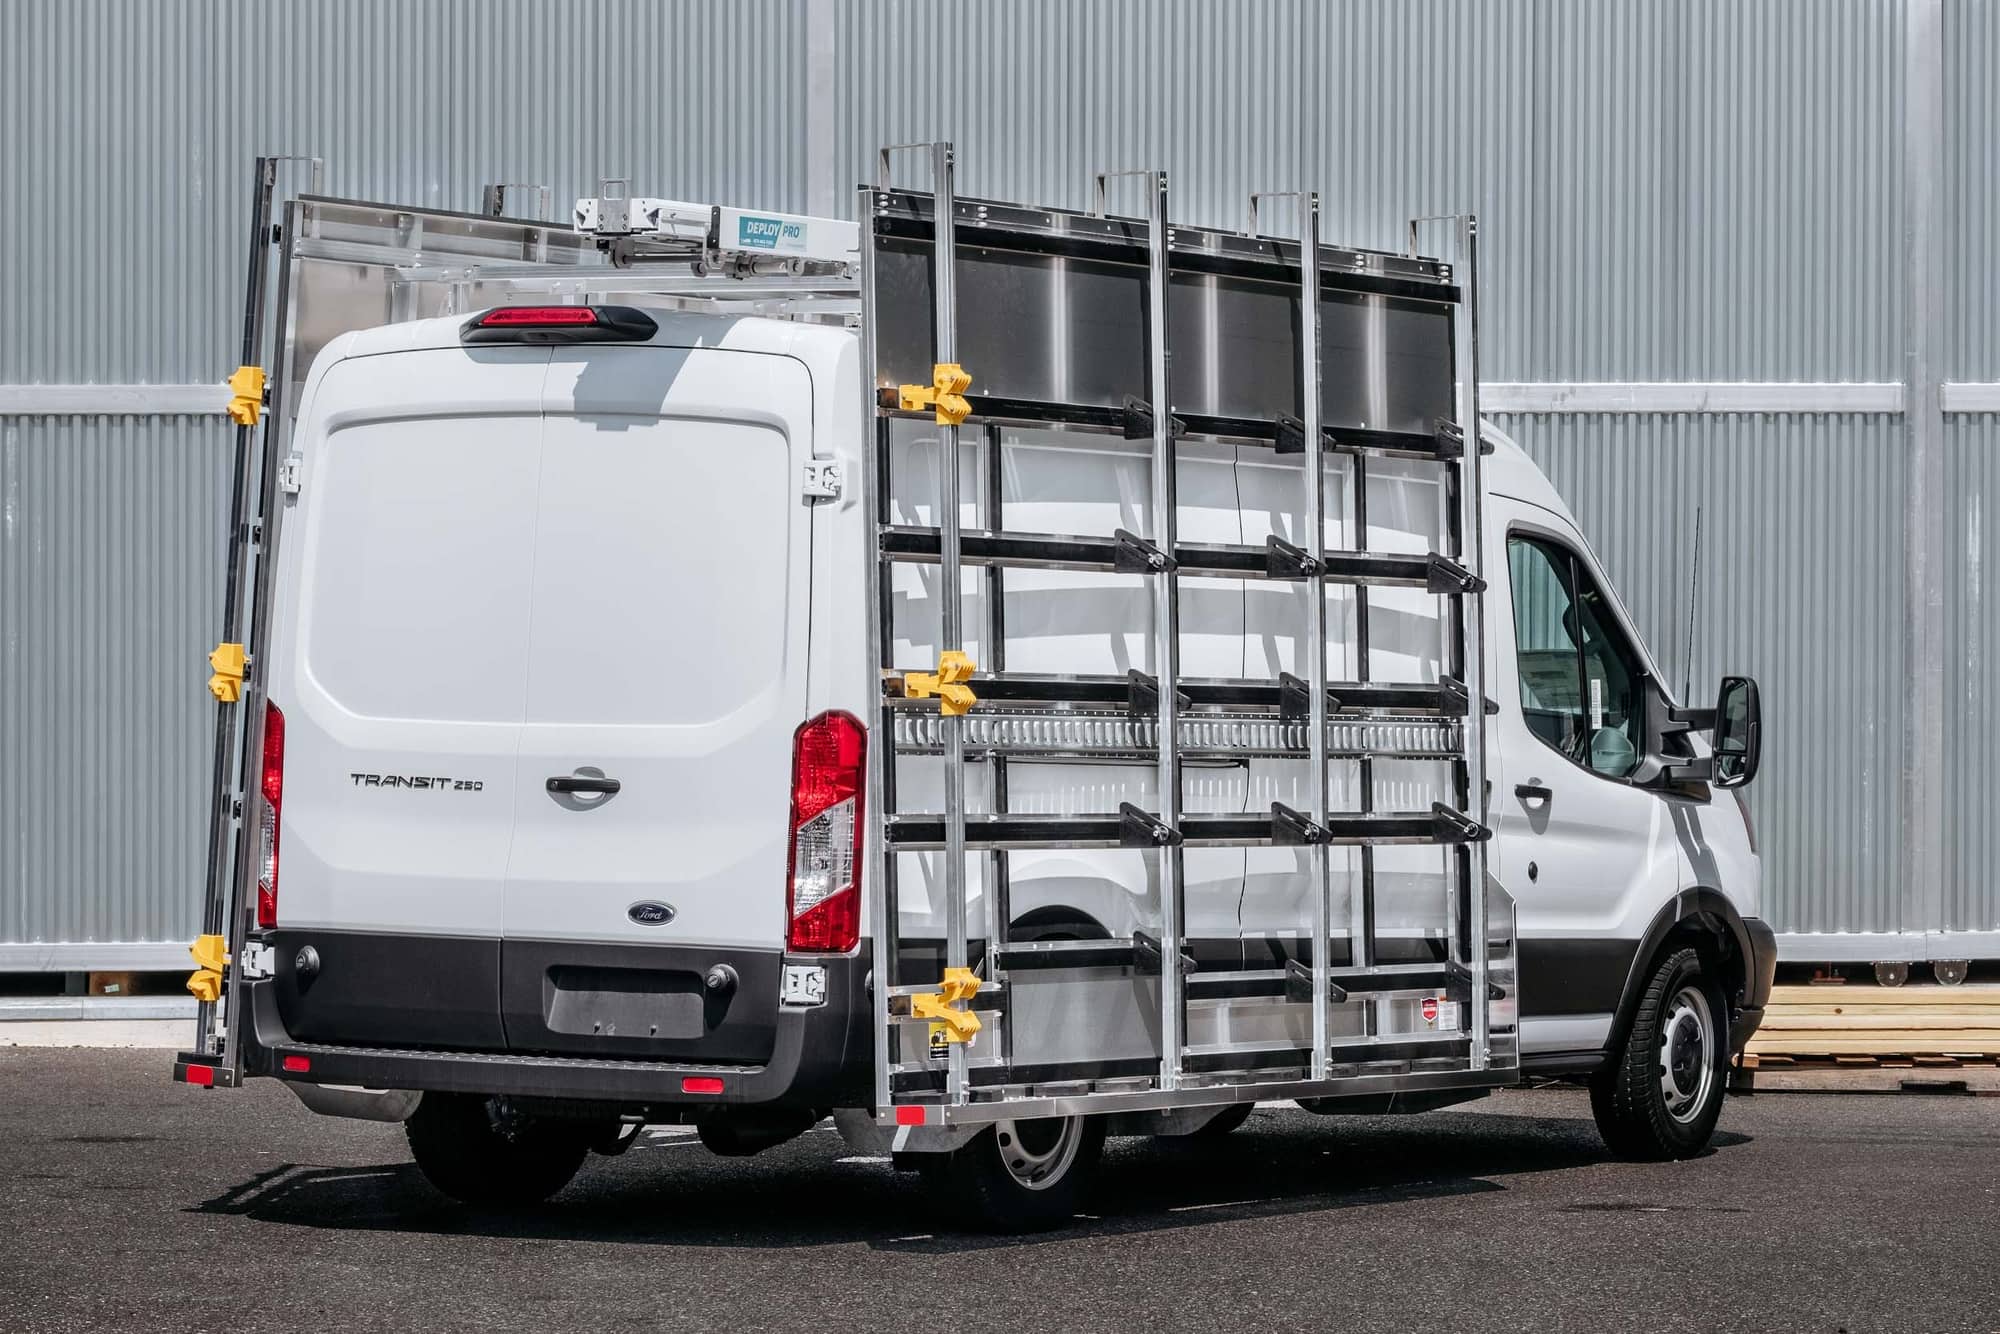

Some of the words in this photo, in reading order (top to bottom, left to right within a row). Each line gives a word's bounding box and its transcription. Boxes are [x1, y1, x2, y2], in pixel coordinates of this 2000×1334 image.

[746, 222, 781, 237] DEPLOY
[782, 225, 801, 239] PRO
[350, 773, 452, 790] TRANSIT
[453, 780, 484, 791] 250
